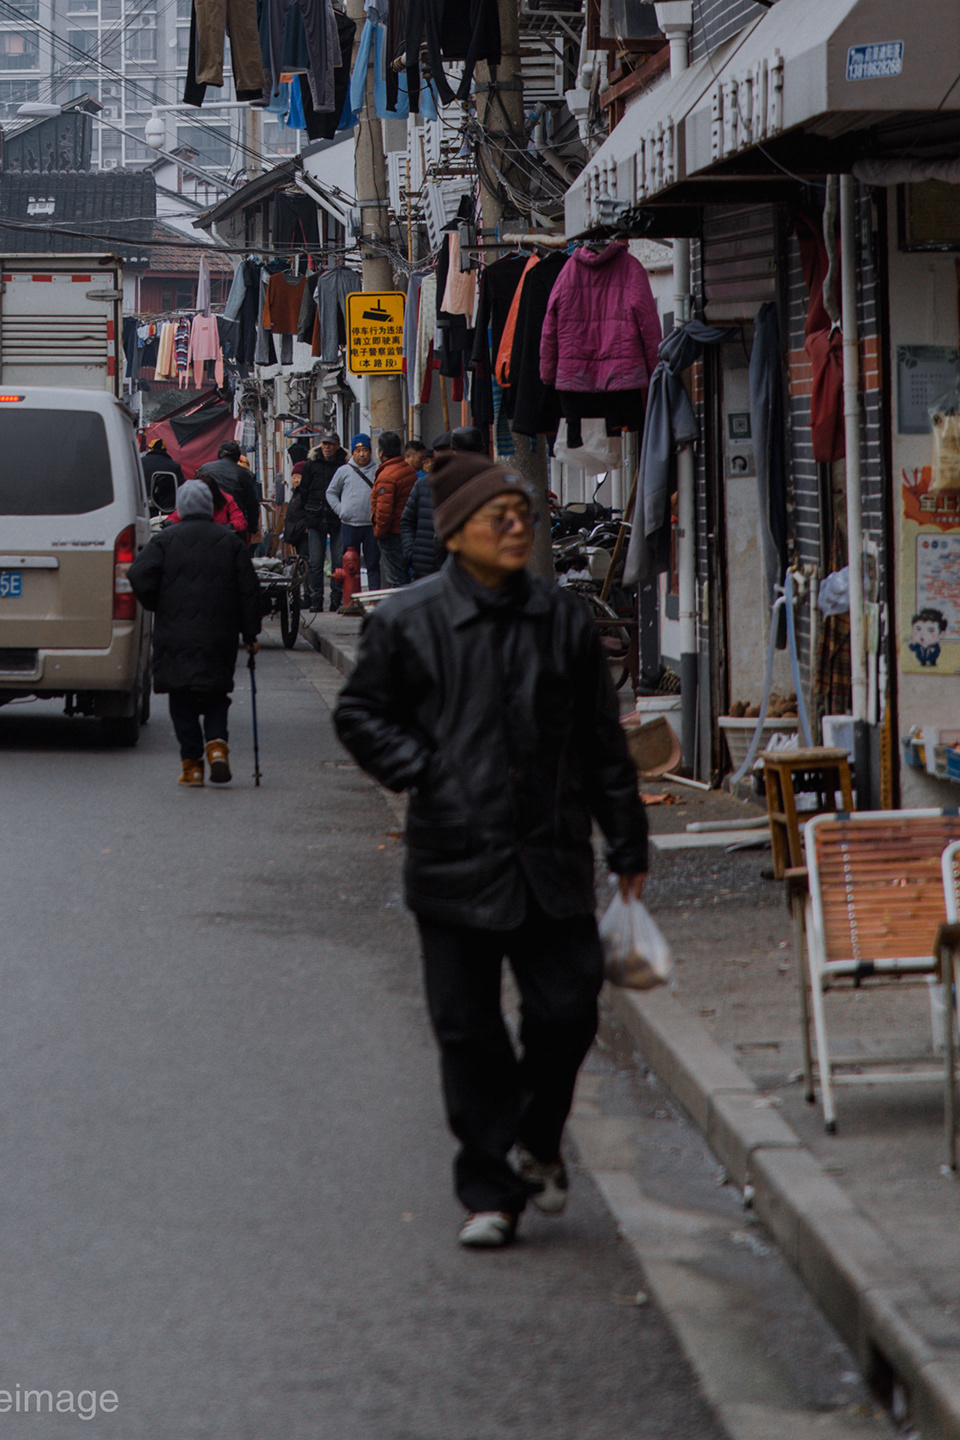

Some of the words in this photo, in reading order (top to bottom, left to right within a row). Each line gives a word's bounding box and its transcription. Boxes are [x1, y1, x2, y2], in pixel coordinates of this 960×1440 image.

[352, 326, 403, 336] 停车行为违法
[353, 336, 400, 346] 请立即驶离
[351, 347, 403, 357] 电子警察监管
[919, 493, 960, 512] 全上
